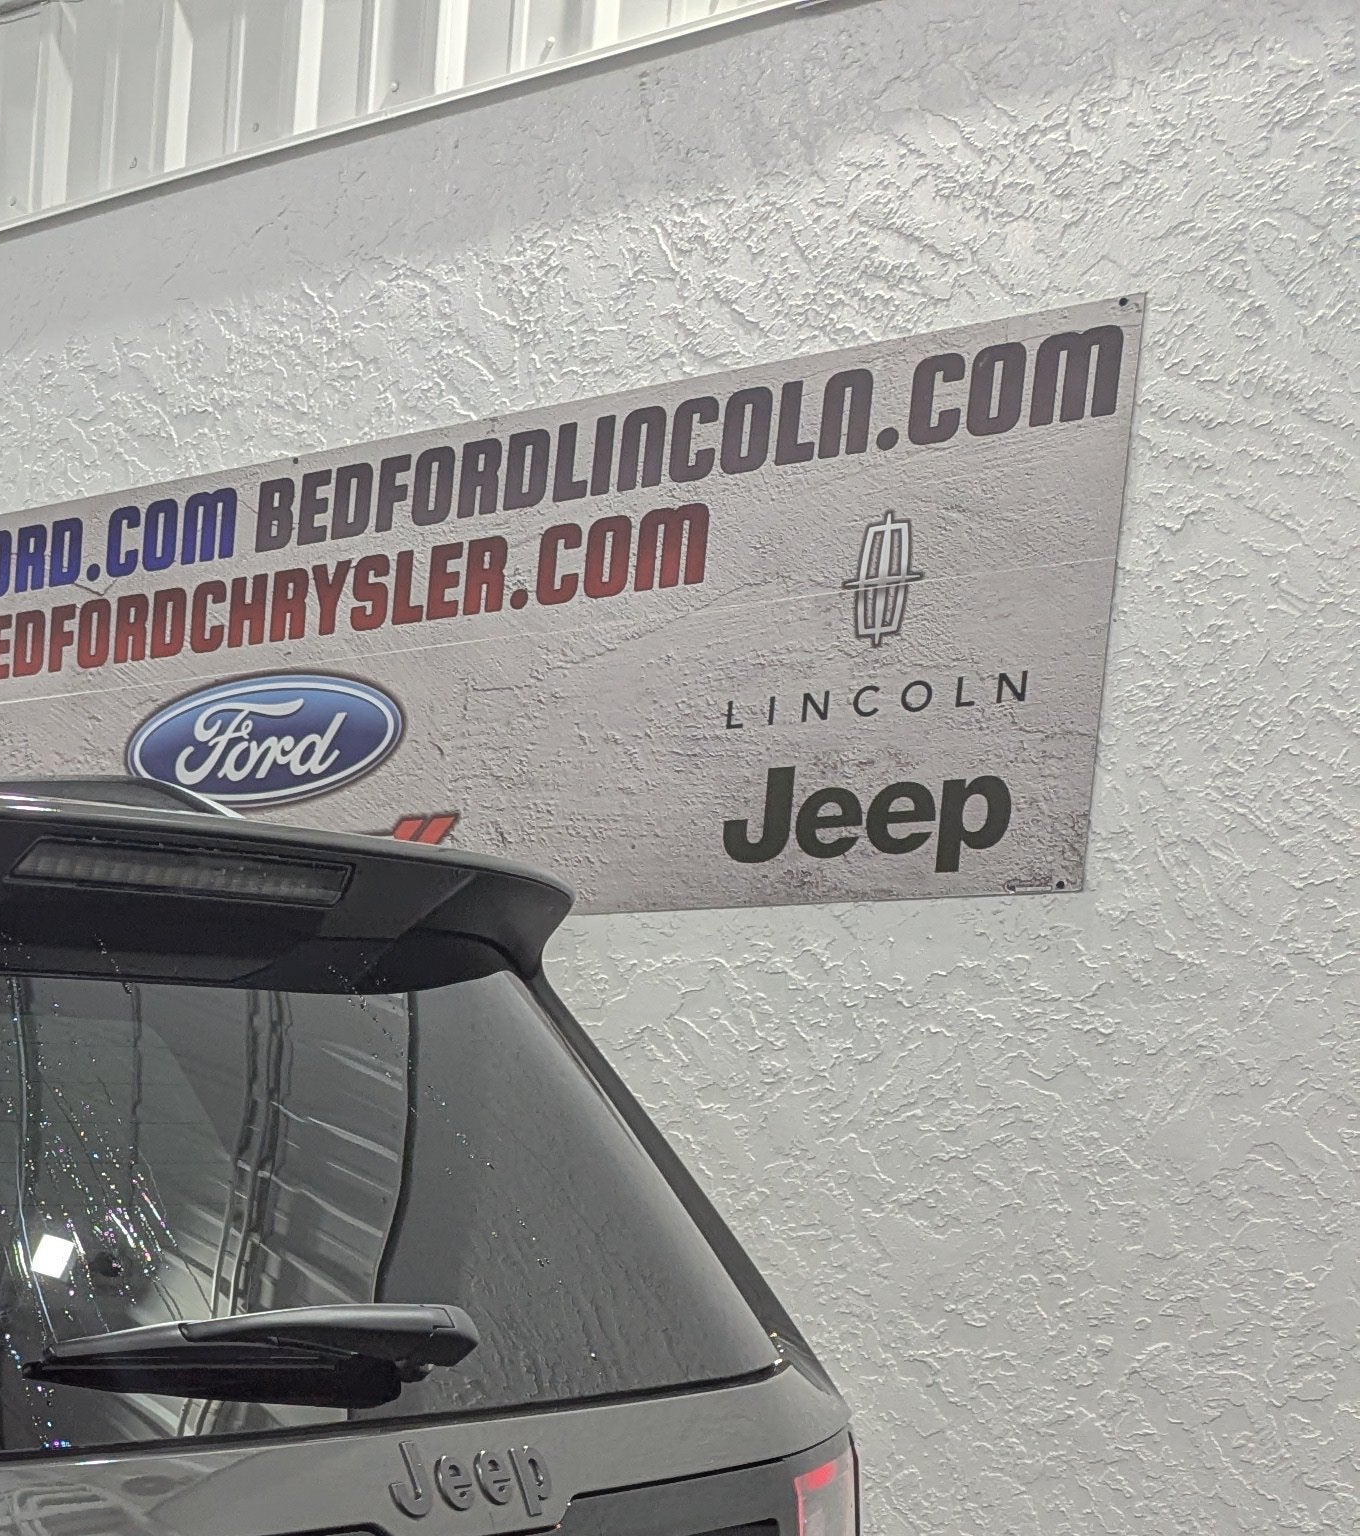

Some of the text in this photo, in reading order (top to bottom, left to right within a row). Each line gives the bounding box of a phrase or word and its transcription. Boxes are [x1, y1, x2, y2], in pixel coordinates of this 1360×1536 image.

[175, 697, 348, 785] Ford
[726, 670, 1029, 730] LINCOLN
[723, 766, 1012, 873] Jeep
[389, 1440, 552, 1518] Jeep
